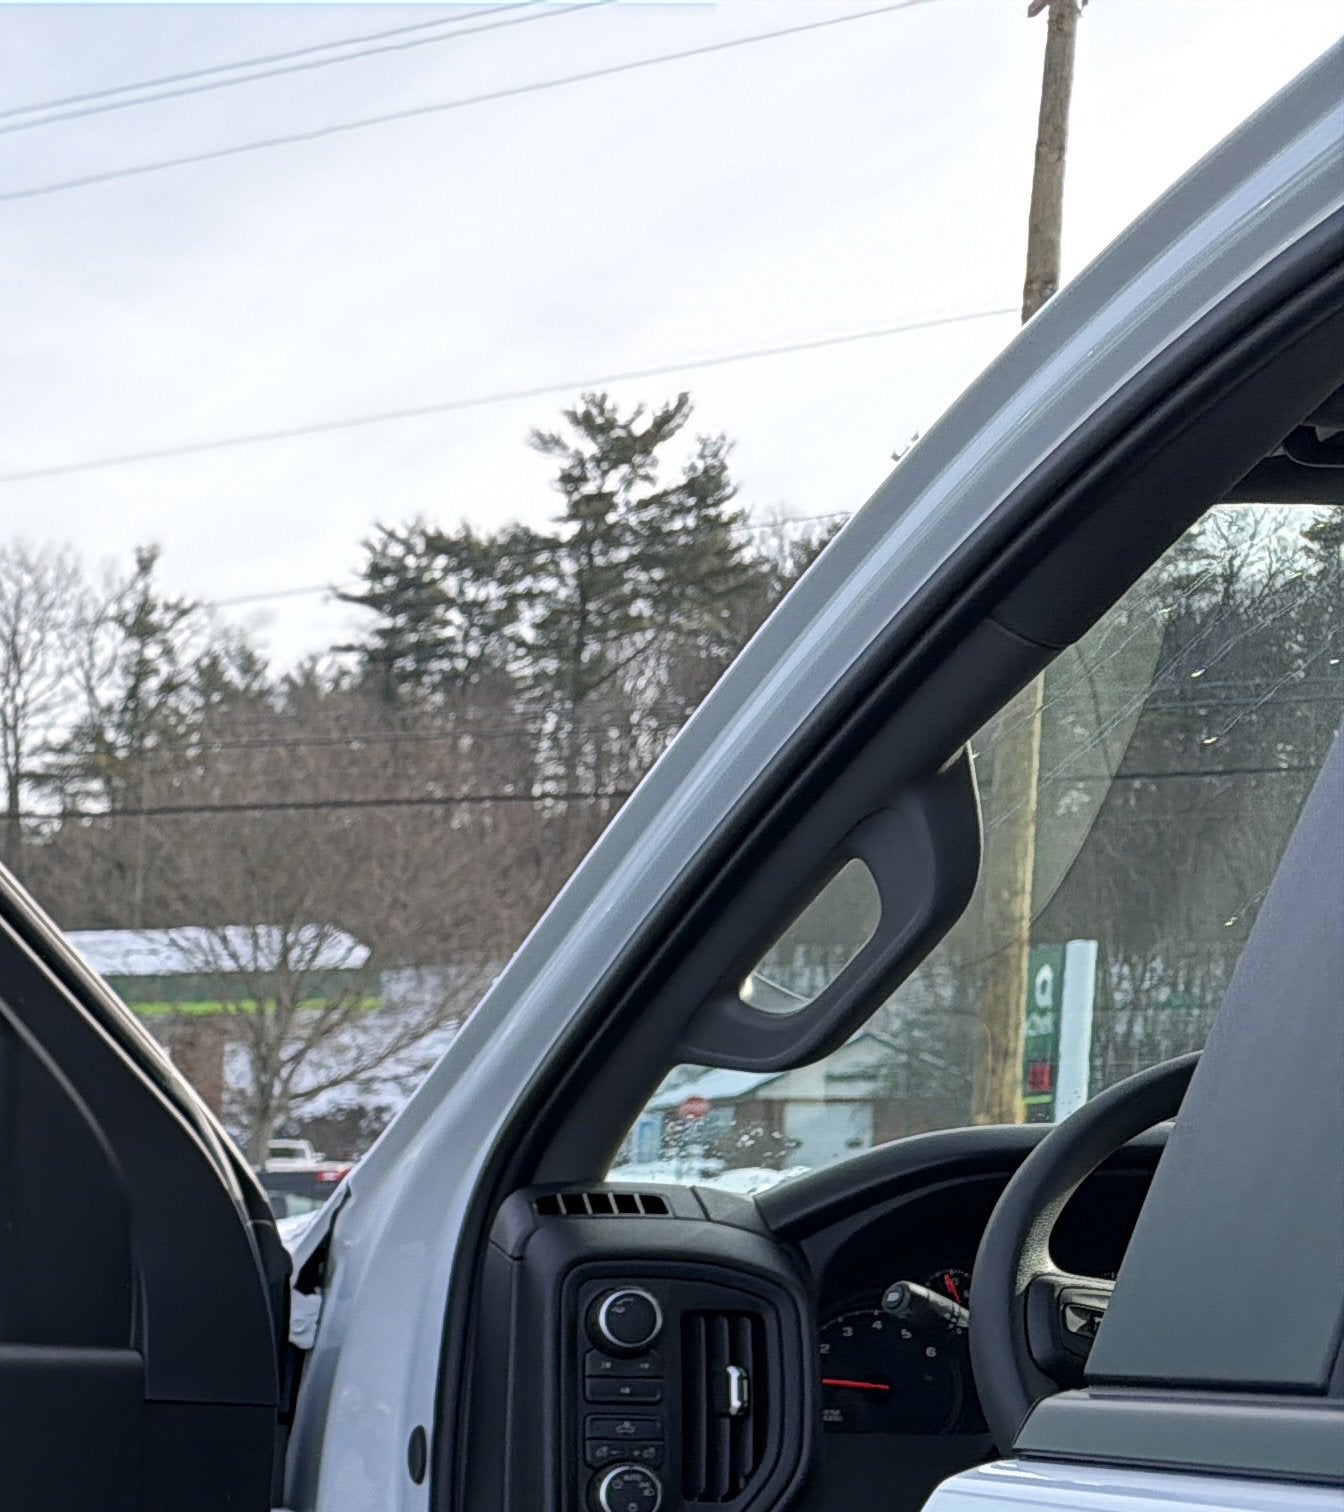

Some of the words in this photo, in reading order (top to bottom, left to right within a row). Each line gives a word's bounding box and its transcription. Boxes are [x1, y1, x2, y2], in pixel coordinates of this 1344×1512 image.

[872, 1320, 883, 1330] 4
[843, 1326, 854, 1337] 3
[901, 1328, 912, 1339] 5
[820, 1343, 831, 1354] 2
[926, 1346, 937, 1357] 6
